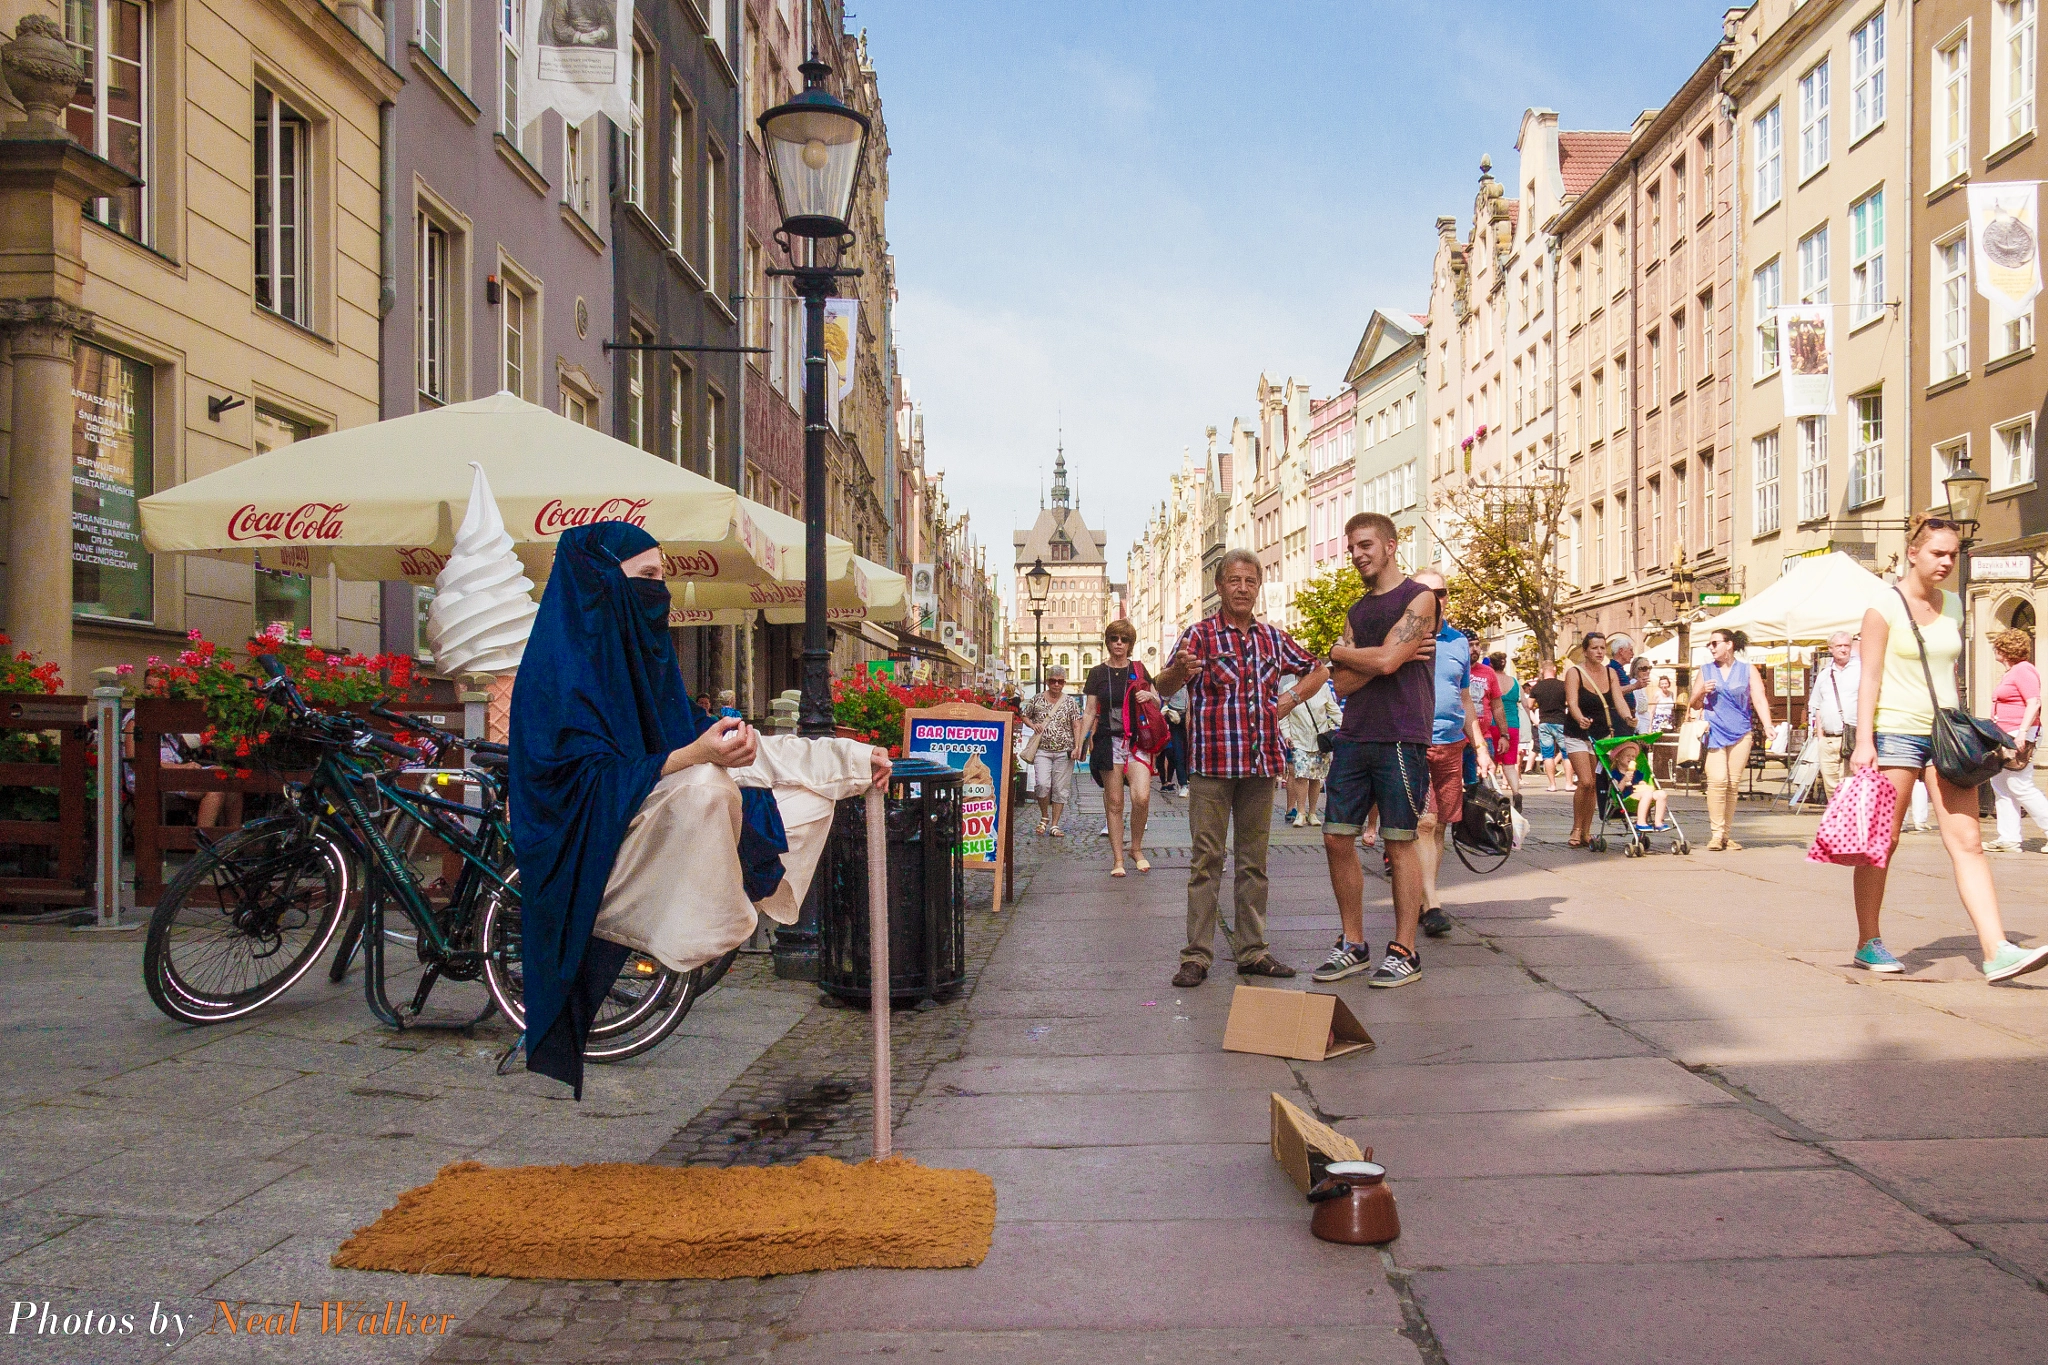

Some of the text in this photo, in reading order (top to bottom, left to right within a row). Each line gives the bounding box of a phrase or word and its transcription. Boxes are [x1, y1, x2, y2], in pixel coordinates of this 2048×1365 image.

[71, 388, 135, 415] APRASZAMY NA
[78, 408, 123, 431] ŚNIADANIA
[85, 422, 116, 438] OBIADY
[84, 432, 118, 449] KOLACJE
[76, 456, 126, 475] SERWUJEMY
[88, 469, 115, 483] DANIA
[72, 511, 131, 531] ORGANIZUJEMY
[227, 502, 350, 541] Coca-Cola
[90, 535, 114, 547] ORAZ
[101, 528, 140, 542] BANKIETY
[74, 542, 129, 559] INNE IMPREZY
[1977, 560, 2004, 570] Bazylika
[1702, 595, 1740, 604] SUBWAY
[916, 726, 998, 741] BAR NEPTUN
[931, 743, 987, 753] ZAPRASZA
[961, 801, 994, 814] SUPER
[961, 839, 994, 855] SKIE
